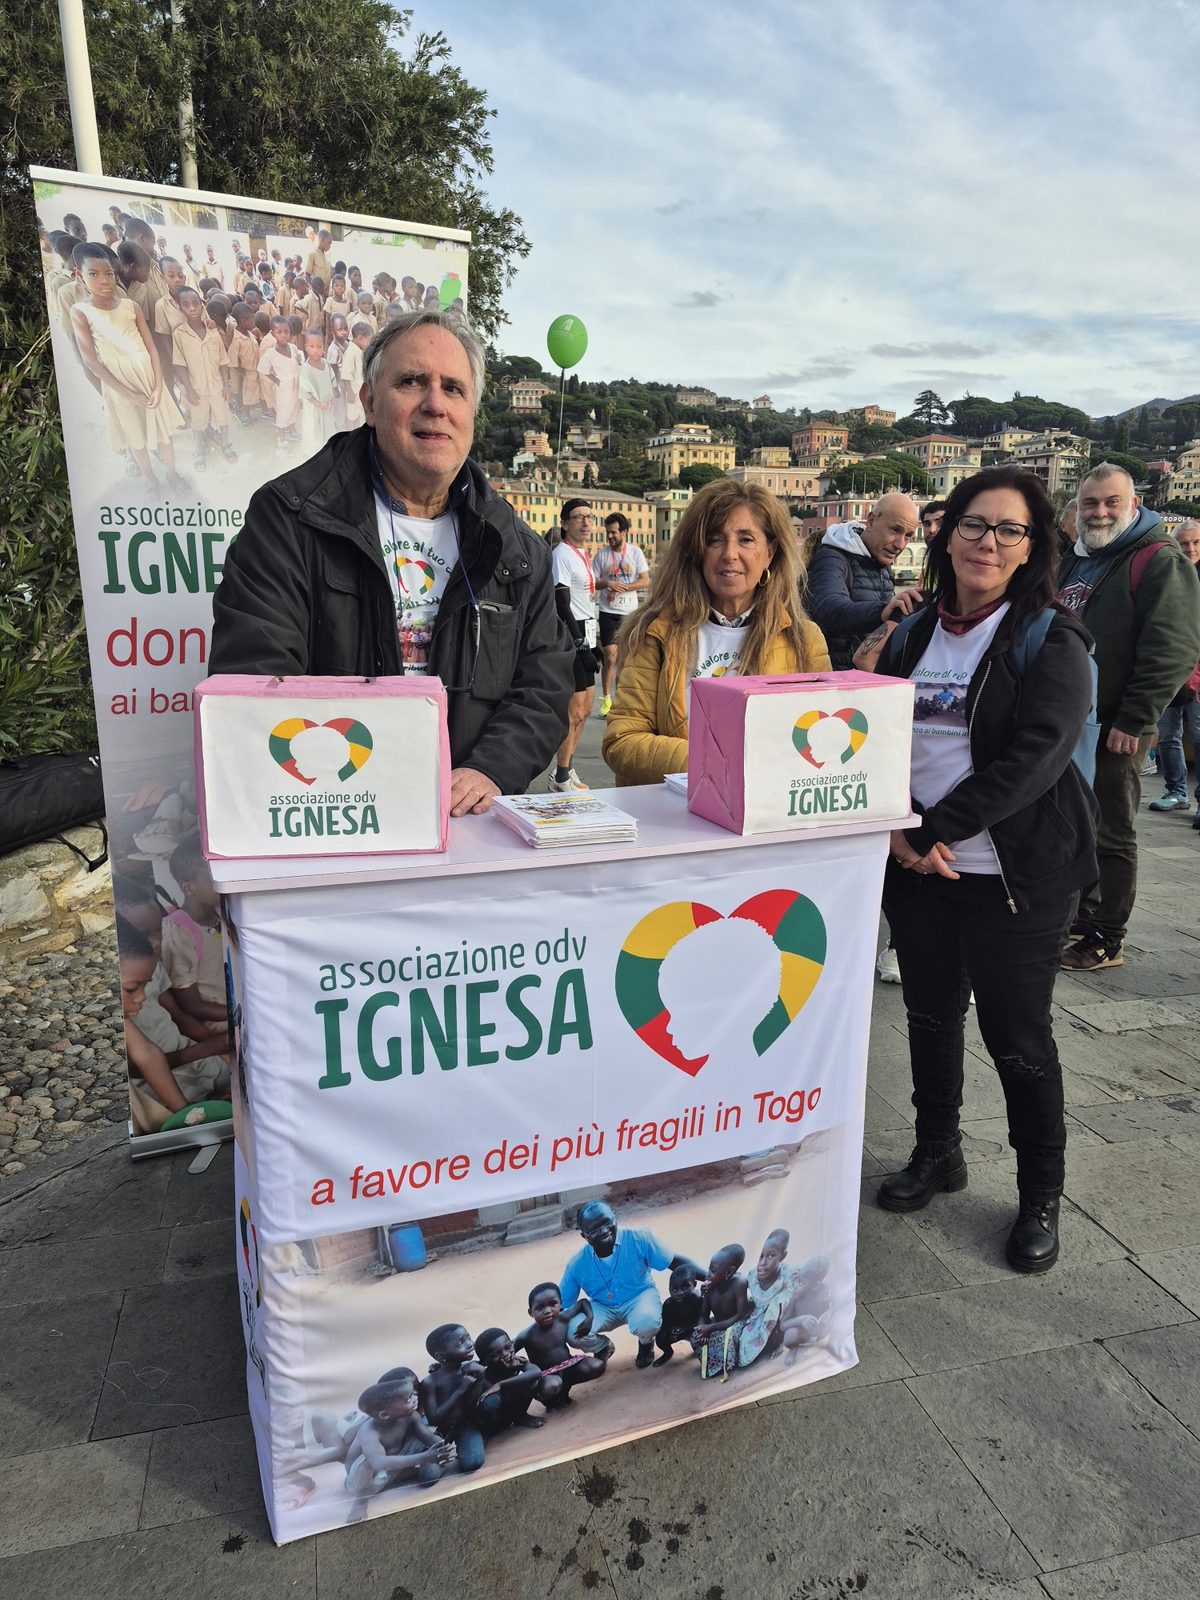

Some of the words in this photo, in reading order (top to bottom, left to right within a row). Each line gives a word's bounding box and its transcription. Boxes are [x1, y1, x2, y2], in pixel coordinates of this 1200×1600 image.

[100, 501, 243, 527] associazione
[98, 531, 239, 595] IGNE
[382, 539, 411, 557] alore
[413, 541, 425, 553] al
[427, 547, 446, 565] tuo
[106, 617, 206, 667] don
[402, 664, 430, 672] ribut
[701, 652, 730, 670] valore
[914, 667, 942, 679] alore
[110, 689, 137, 715] ai
[149, 687, 194, 714] ba
[924, 726, 931, 734] ai
[932, 727, 960, 737] bambini
[790, 773, 849, 788] associazione
[851, 770, 868, 783] odv
[270, 792, 351, 805] associazione
[354, 790, 377, 803] odv
[787, 783, 868, 816] IGNESA
[268, 804, 380, 837] IGNESA
[318, 940, 526, 992] associazione
[534, 927, 588, 966] odv
[314, 968, 594, 1090] IGNESA
[310, 1176, 336, 1207] a
[349, 1153, 471, 1201] favore
[482, 1133, 540, 1175] dei
[550, 1122, 606, 1173] più
[616, 1105, 705, 1153] fragili
[715, 1099, 742, 1134] in
[752, 1086, 823, 1124] Togo
